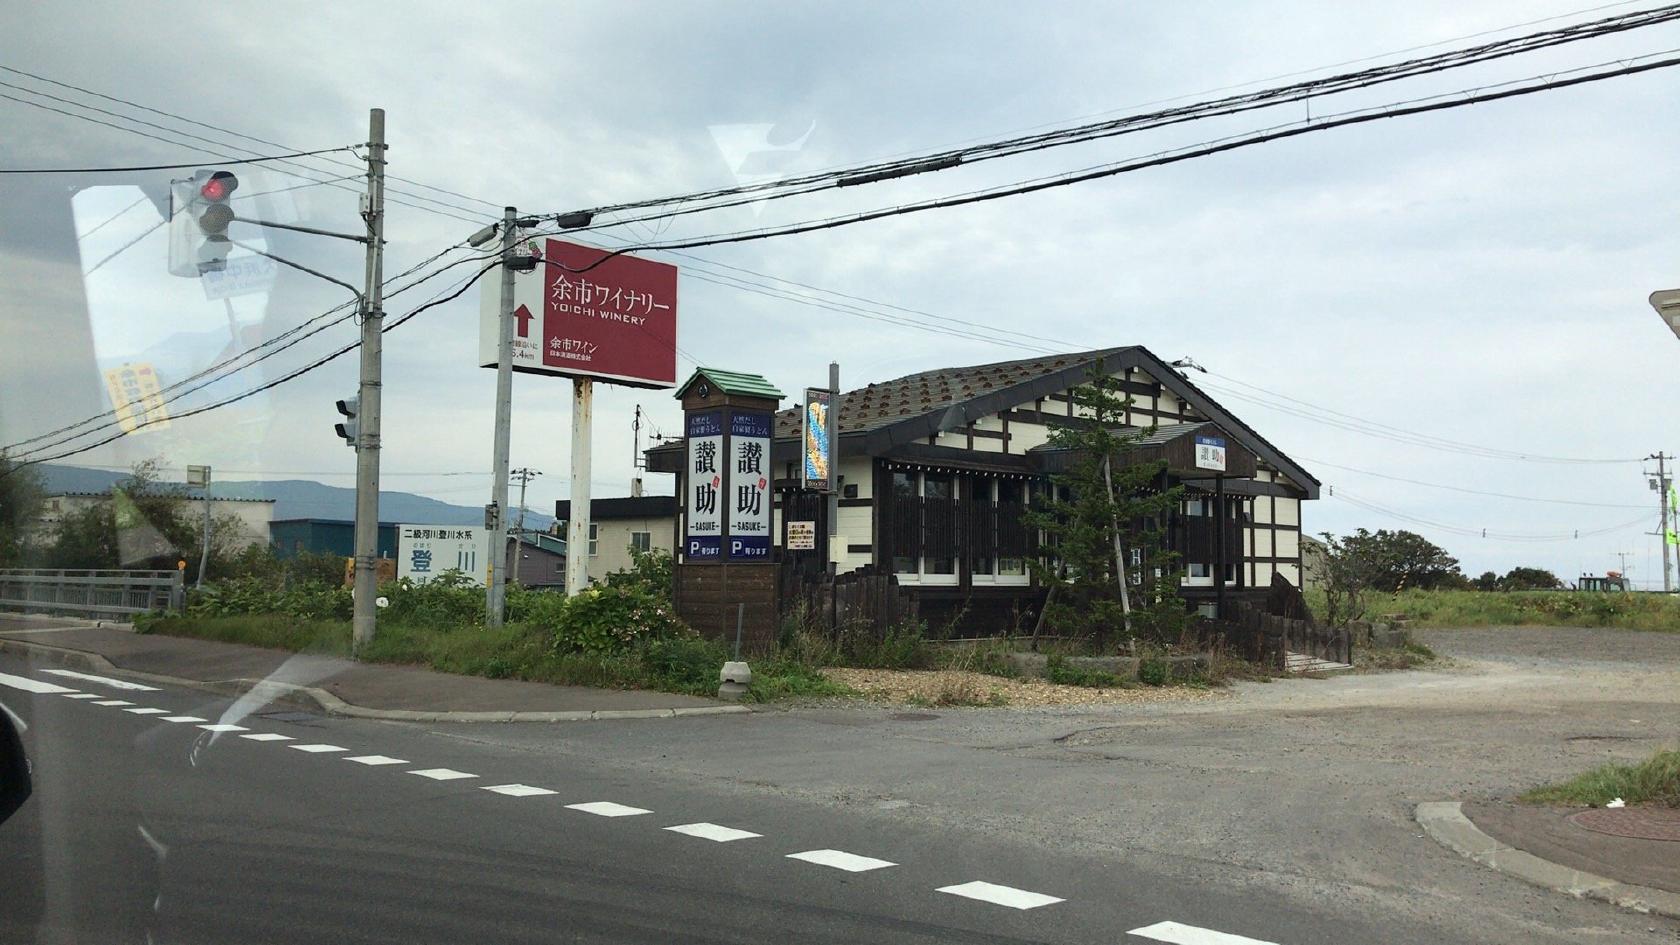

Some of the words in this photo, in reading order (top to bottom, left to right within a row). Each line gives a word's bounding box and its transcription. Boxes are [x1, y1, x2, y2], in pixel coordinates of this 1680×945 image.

[551, 274, 670, 315] 余市ワイナリー
[551, 302, 595, 317] YOICHI
[599, 310, 646, 326] WINERY
[550, 336, 598, 354] 余市ワイン
[695, 441, 716, 515] 讃助
[737, 442, 763, 516] 讃助
[404, 529, 473, 540] 二級河川登川水系
[690, 541, 700, 555] P
[732, 541, 742, 554] P
